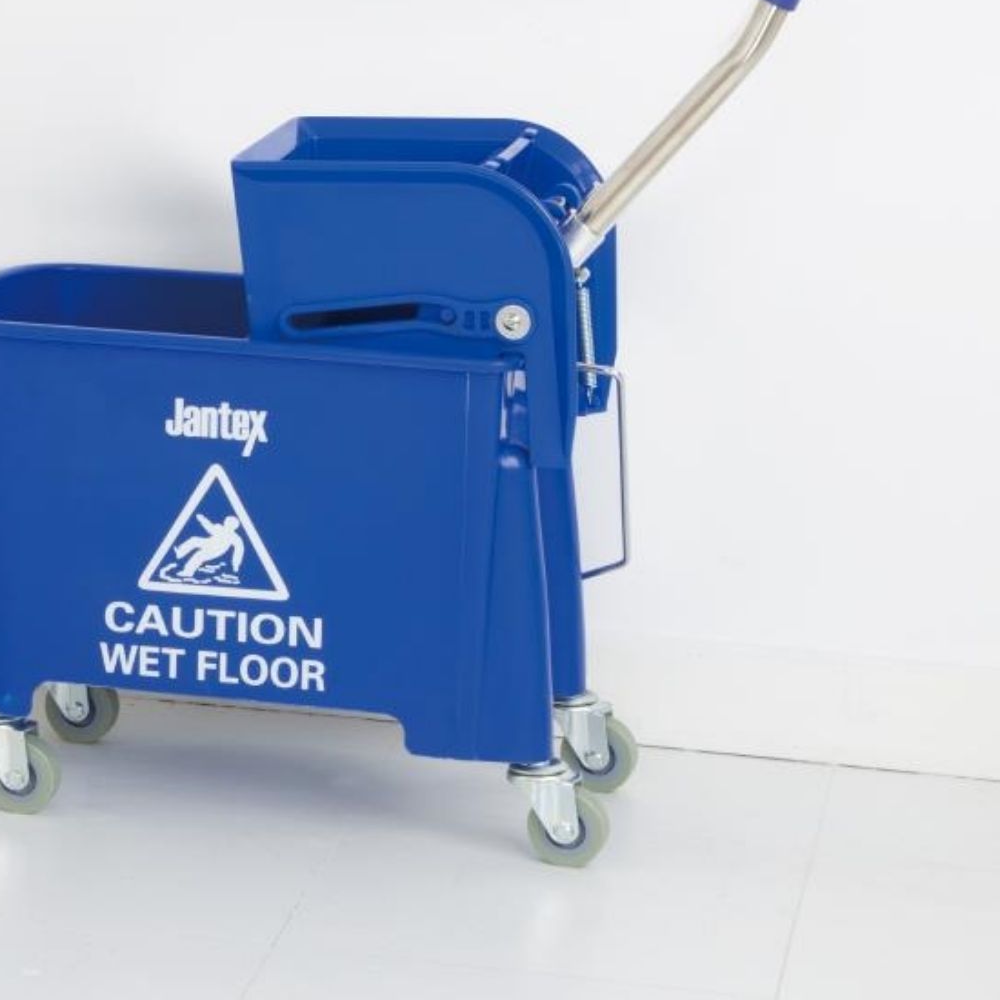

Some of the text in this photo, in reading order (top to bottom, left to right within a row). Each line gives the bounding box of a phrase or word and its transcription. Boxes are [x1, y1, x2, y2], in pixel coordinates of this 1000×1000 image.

[165, 397, 268, 457] Jantex
[104, 601, 323, 650] CAUTION
[100, 641, 326, 692] WET FLOOR
